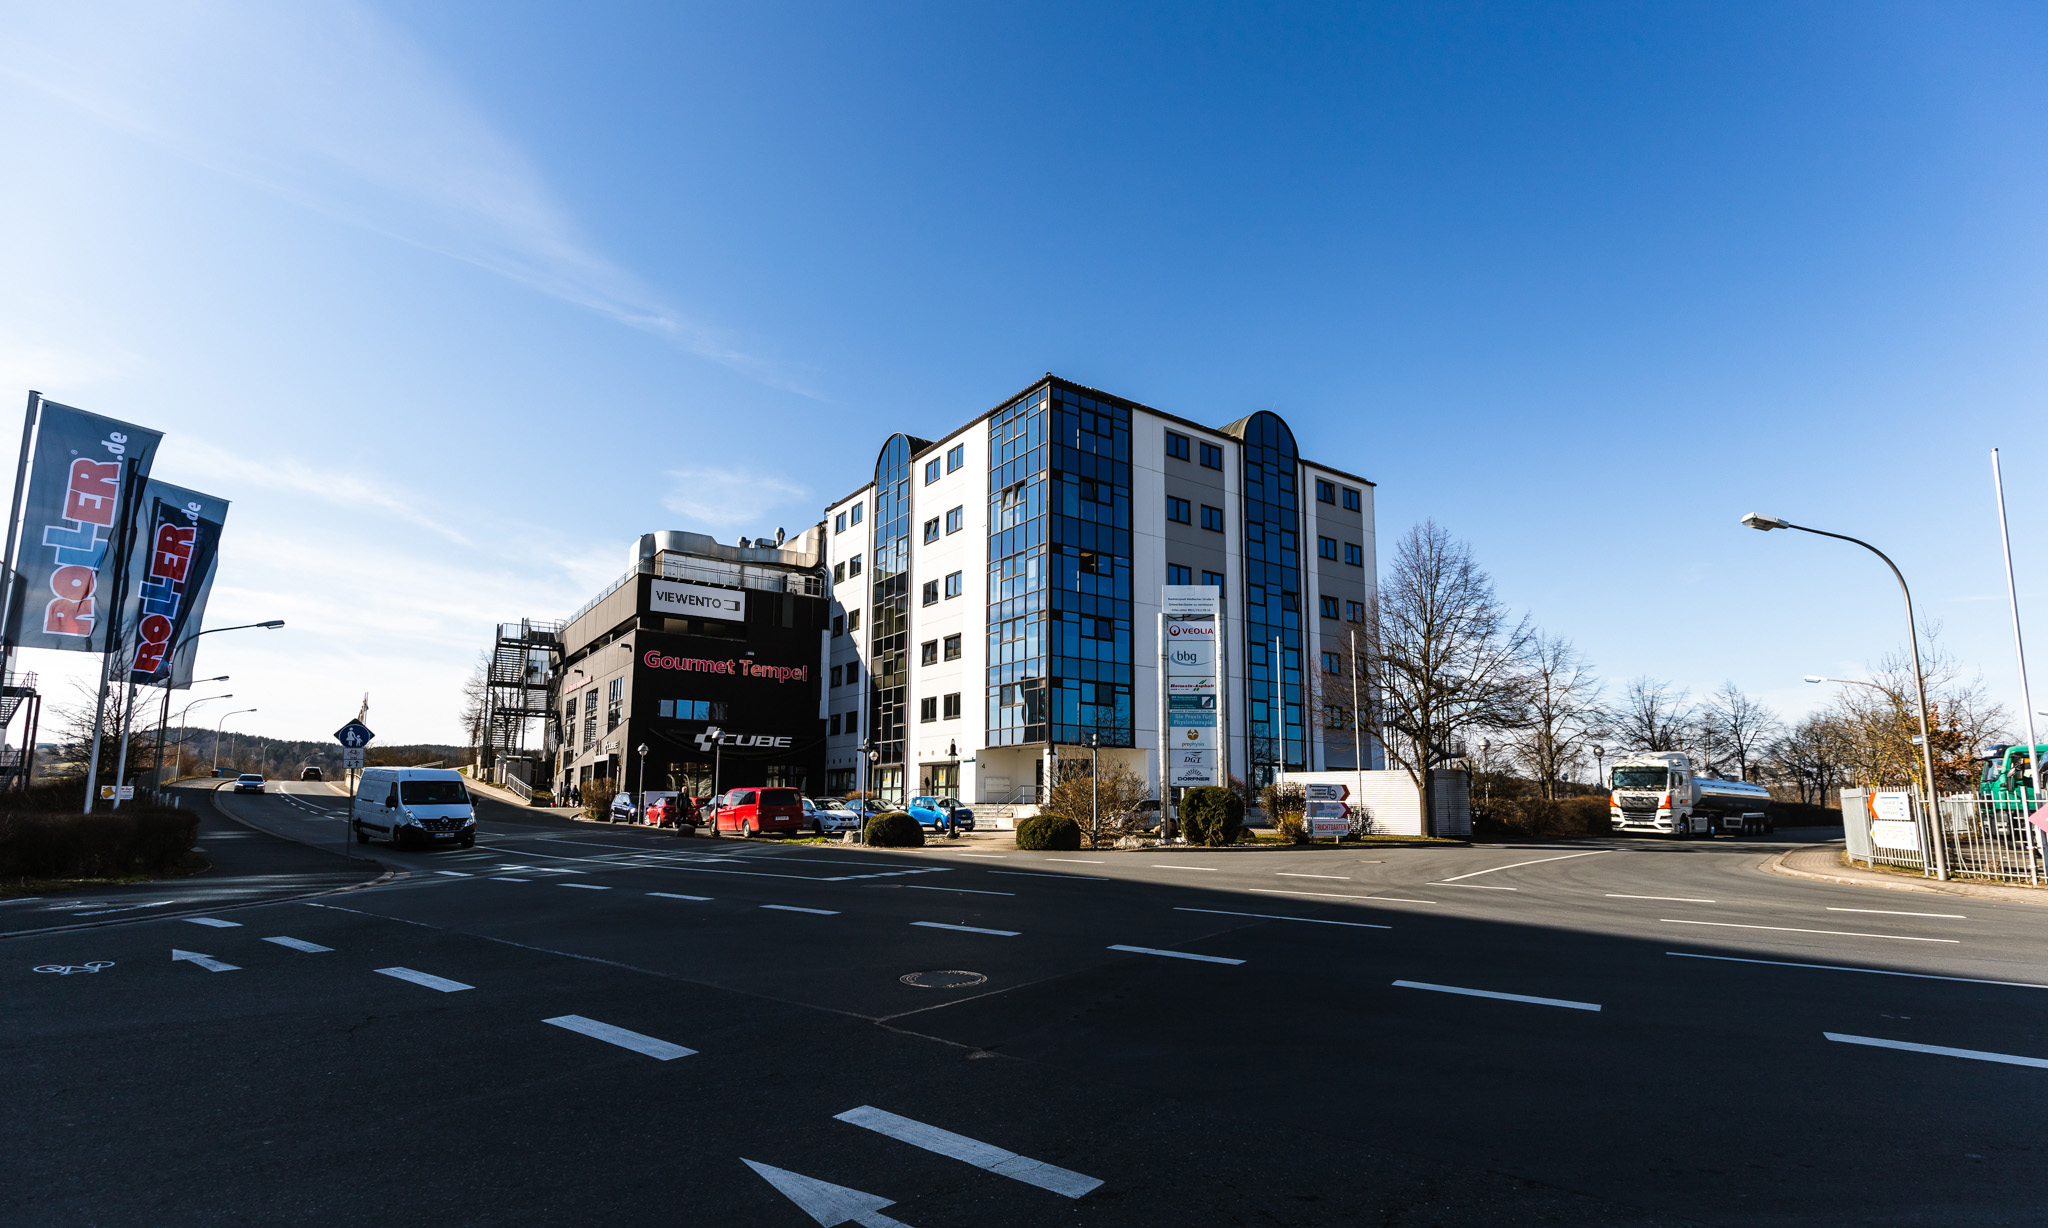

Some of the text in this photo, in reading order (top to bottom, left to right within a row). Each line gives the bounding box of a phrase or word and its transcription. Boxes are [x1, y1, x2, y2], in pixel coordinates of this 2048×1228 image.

[656, 590, 722, 609] VIEWENTO
[1177, 650, 1197, 664] bbg
[644, 650, 808, 683] Gourmet Tempel
[718, 734, 793, 748] CUBE
